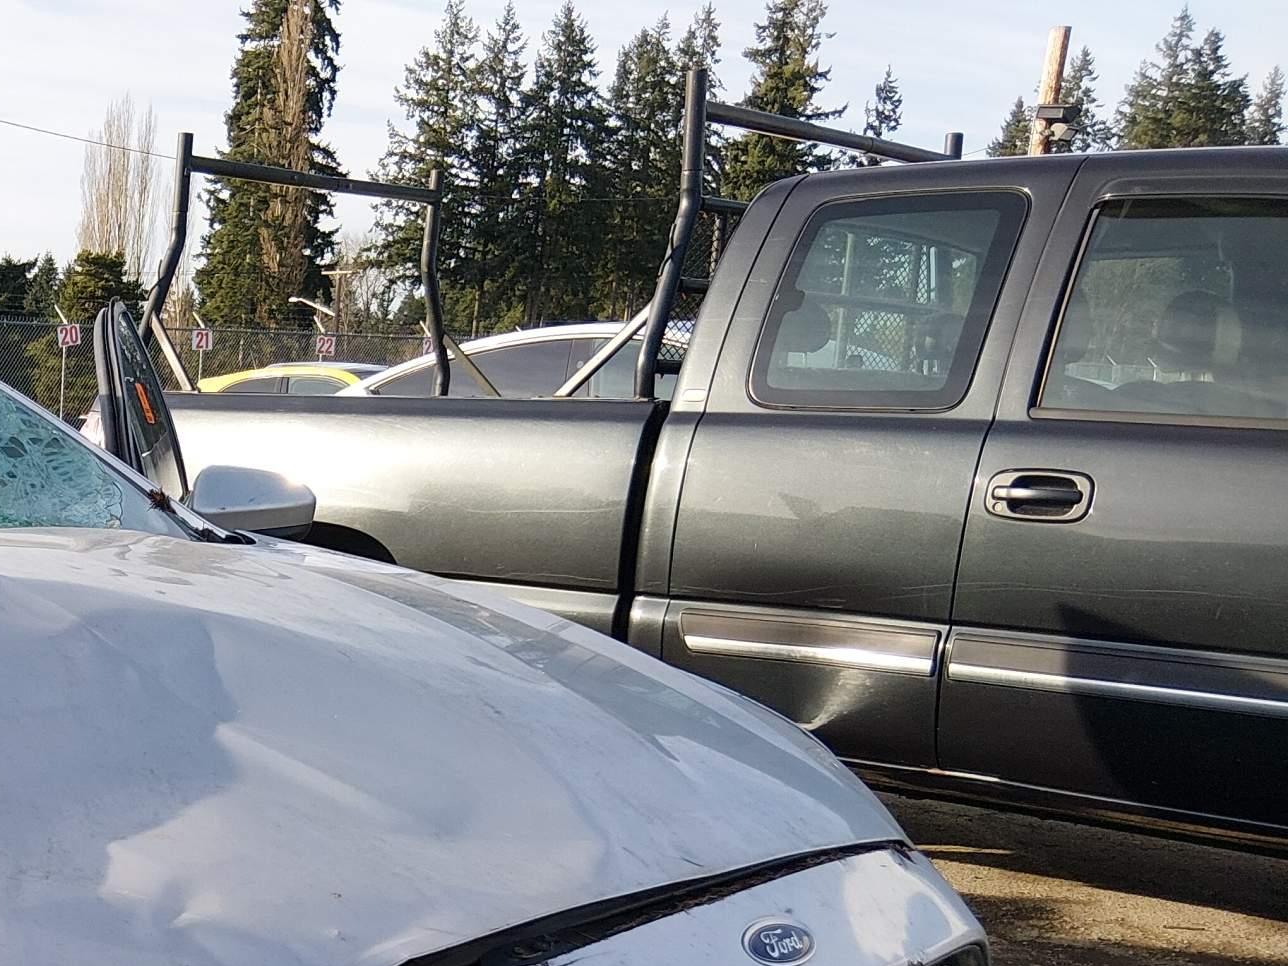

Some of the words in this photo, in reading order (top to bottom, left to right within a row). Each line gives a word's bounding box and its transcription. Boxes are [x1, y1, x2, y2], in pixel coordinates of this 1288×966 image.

[59, 325, 79, 346] 20
[196, 331, 209, 349] 21
[317, 337, 333, 354] 22
[760, 928, 803, 958] Ford
